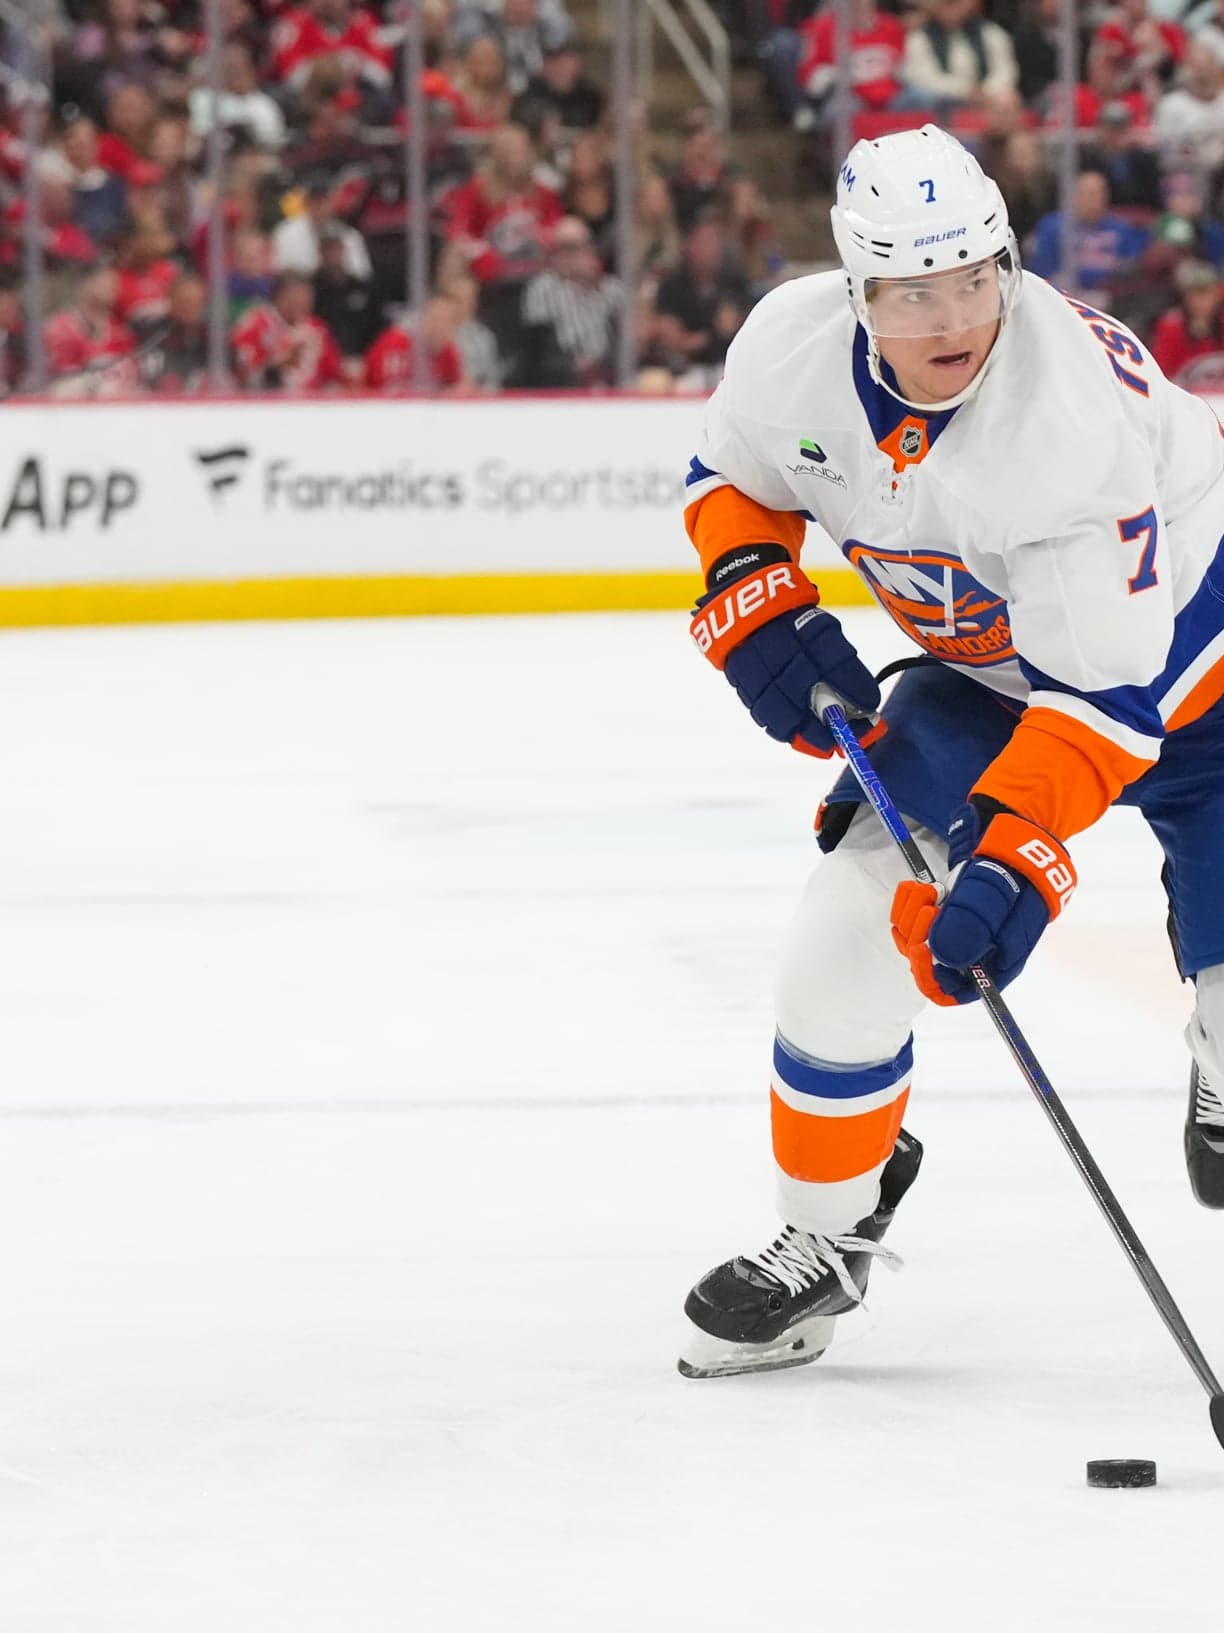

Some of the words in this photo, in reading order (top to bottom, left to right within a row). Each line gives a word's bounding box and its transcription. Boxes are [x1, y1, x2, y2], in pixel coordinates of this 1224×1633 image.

[919, 179, 937, 203] 7
[1043, 279, 1150, 399] TSY
[1, 457, 139, 530] App
[262, 457, 464, 510] Fanatics
[786, 463, 848, 485] VANDA
[715, 552, 760, 582] Reebok
[1116, 503, 1160, 595] 7
